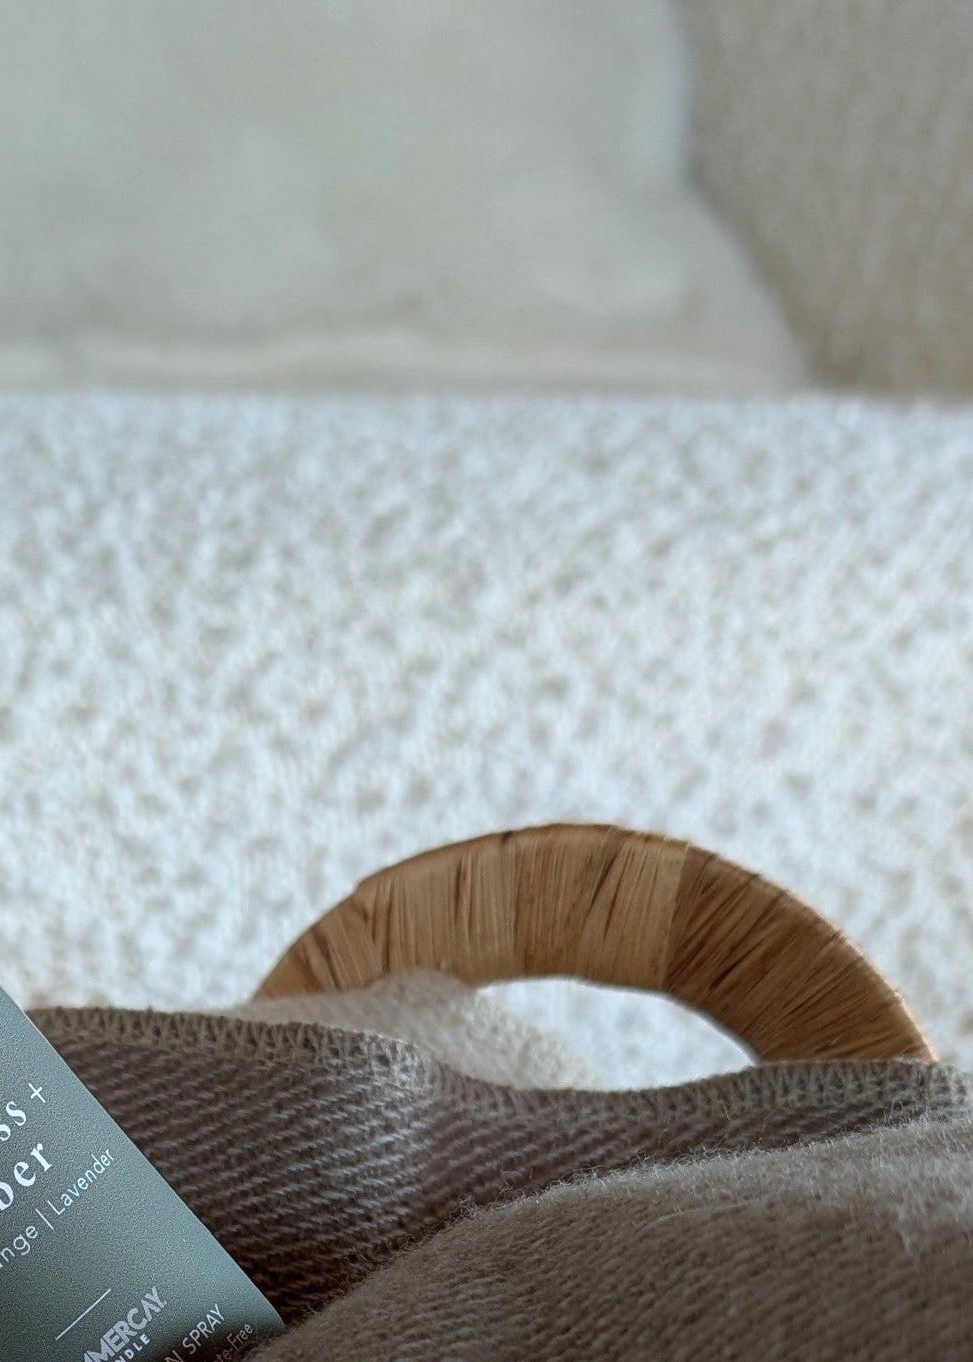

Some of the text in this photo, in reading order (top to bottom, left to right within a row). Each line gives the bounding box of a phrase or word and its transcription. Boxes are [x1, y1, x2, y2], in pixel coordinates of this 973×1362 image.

[28, 1082, 46, 1104] +
[46, 1149, 115, 1216] Lavender
[182, 1303, 225, 1355] SPRAY
